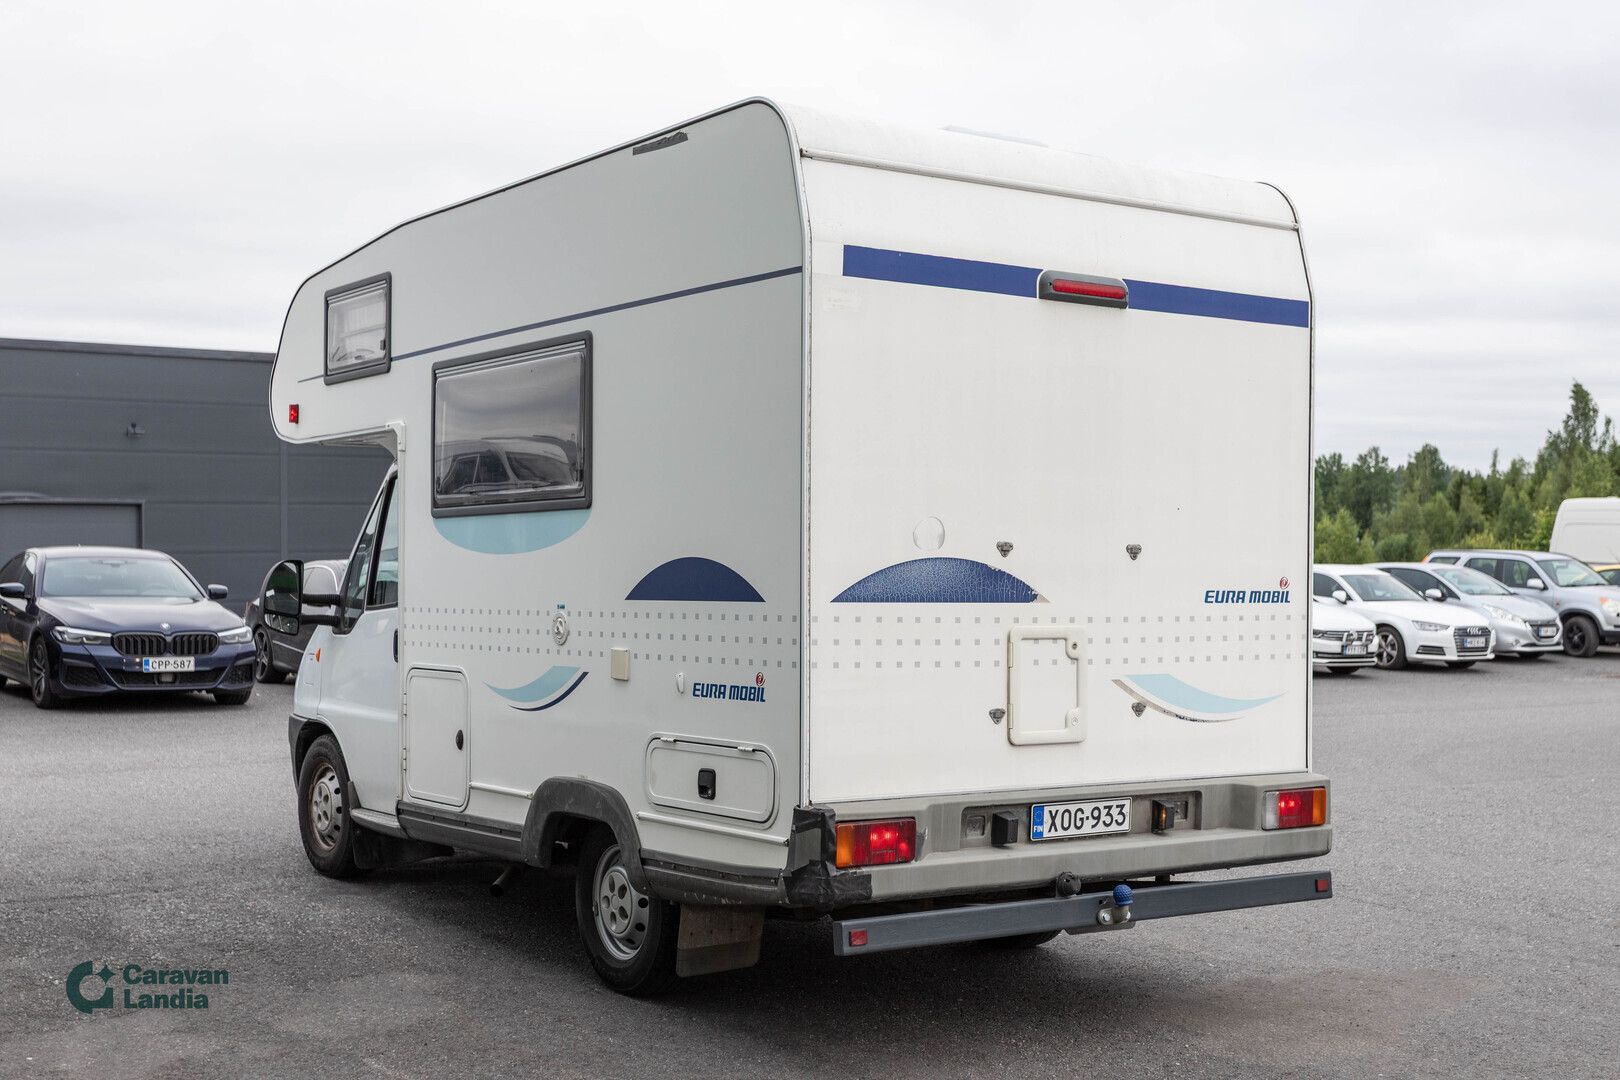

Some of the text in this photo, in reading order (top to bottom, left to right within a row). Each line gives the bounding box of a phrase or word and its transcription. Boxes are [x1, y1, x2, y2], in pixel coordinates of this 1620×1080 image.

[1204, 589, 1290, 604] EURA MOBIL
[151, 659, 192, 670] CPP-587
[692, 682, 766, 703] EURA MOBIL
[1048, 803, 1127, 834] XOG-933
